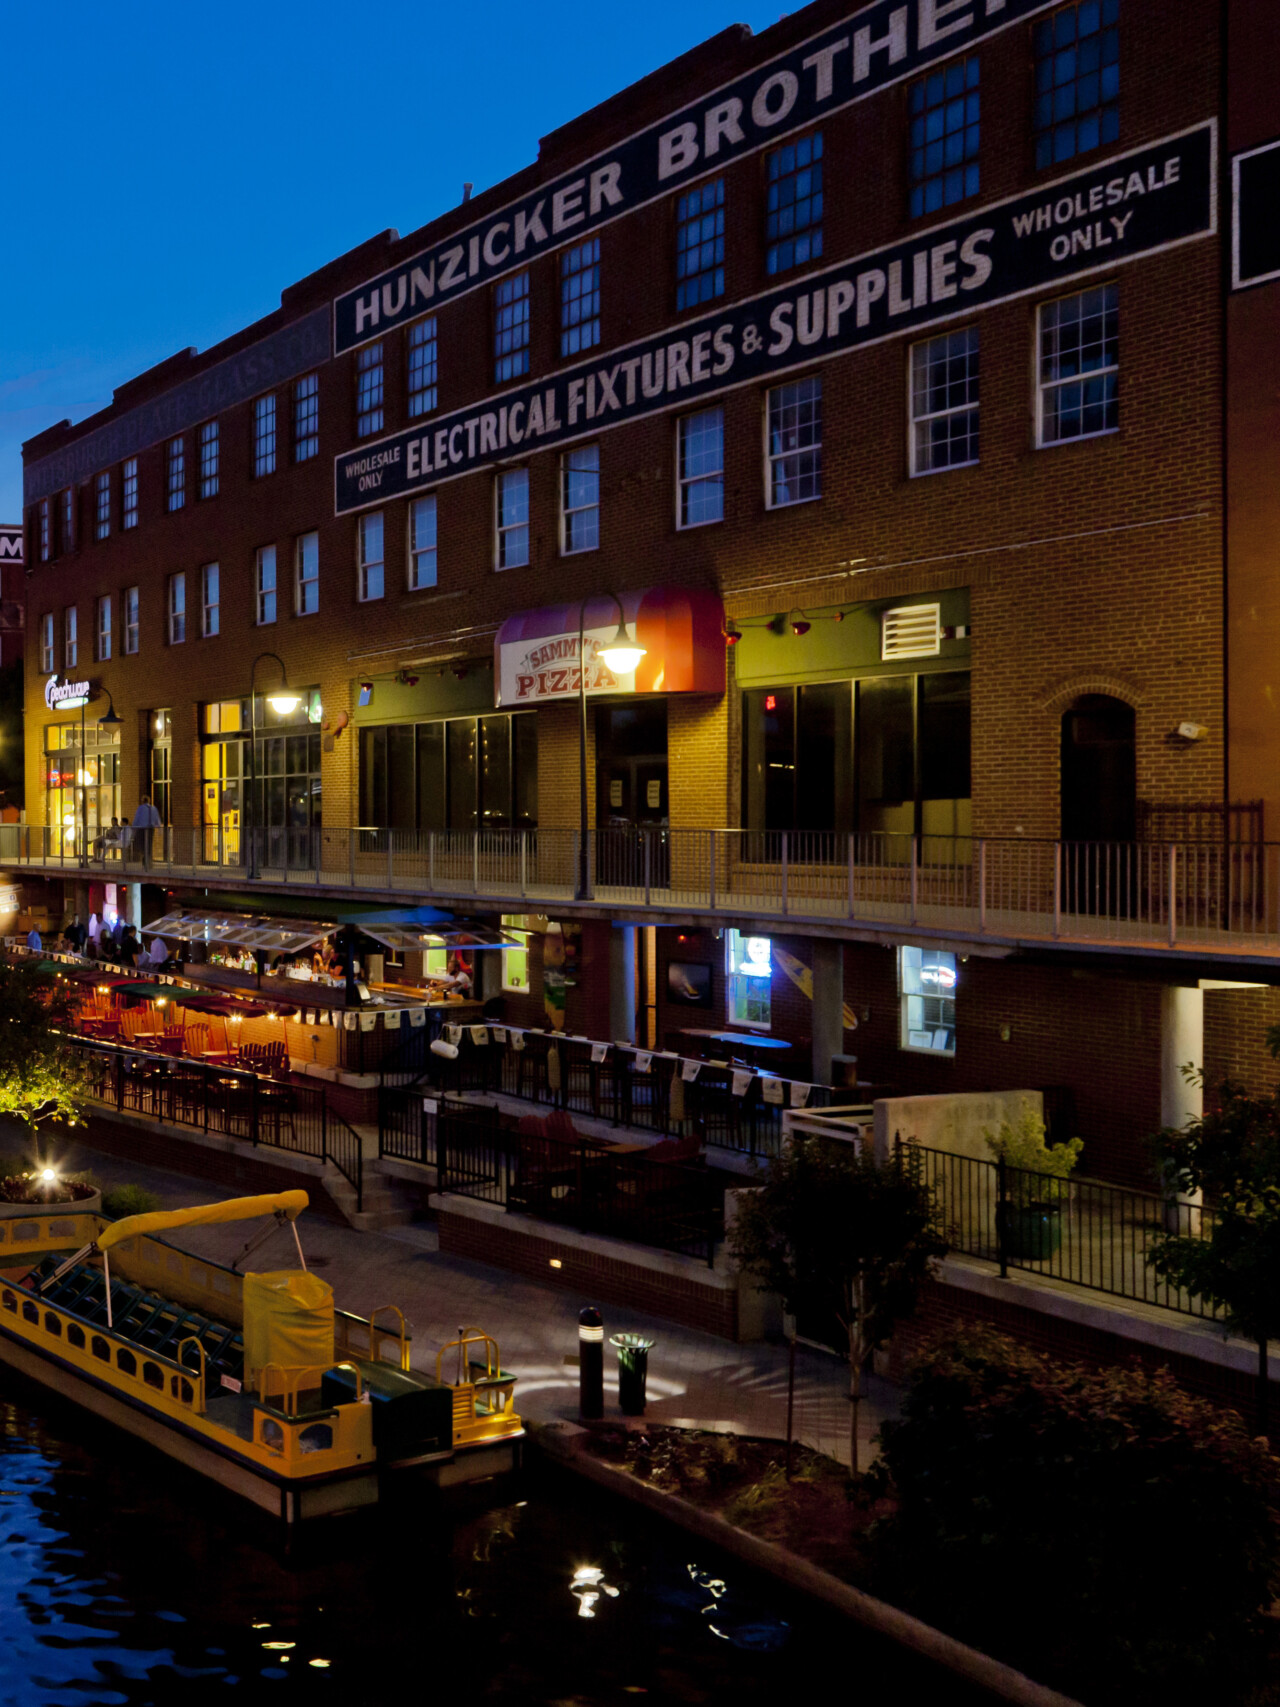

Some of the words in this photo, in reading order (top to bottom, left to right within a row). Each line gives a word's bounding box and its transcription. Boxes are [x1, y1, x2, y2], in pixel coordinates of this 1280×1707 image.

[355, 162, 624, 335] HUNZICKER
[658, 0, 1007, 181] BROTHE
[1011, 155, 1181, 239] WHOLESALE
[1049, 210, 1134, 262] ONLY
[406, 388, 562, 479] ELECTRICAL
[567, 323, 736, 426] FIXTURES
[741, 324, 764, 355] &
[767, 228, 996, 357] SUPPLIES
[345, 446, 401, 479] WHOLESALE
[358, 470, 384, 492] ONLY
[529, 637, 602, 669] SAMMY'S
[516, 666, 618, 699] PIZZA
